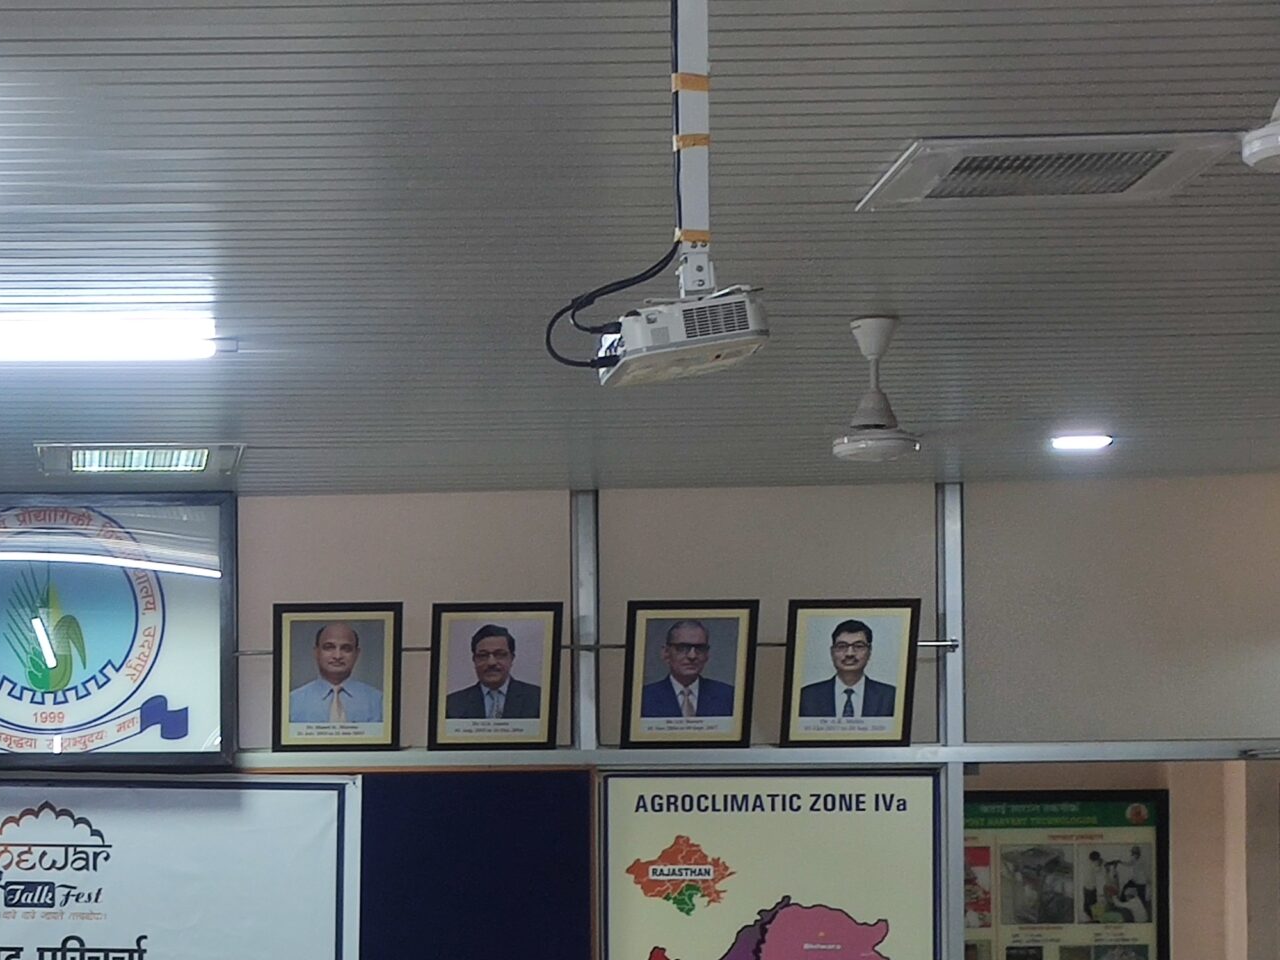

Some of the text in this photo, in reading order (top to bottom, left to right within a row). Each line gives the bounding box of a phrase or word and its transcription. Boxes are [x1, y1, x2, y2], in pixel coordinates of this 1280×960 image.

[33, 711, 65, 724] 1999
[635, 793, 908, 813] AGROCLIMATIC ZONE IVa
[651, 867, 711, 877] RAJASTHAN
[6, 884, 103, 907] Talk Fest
